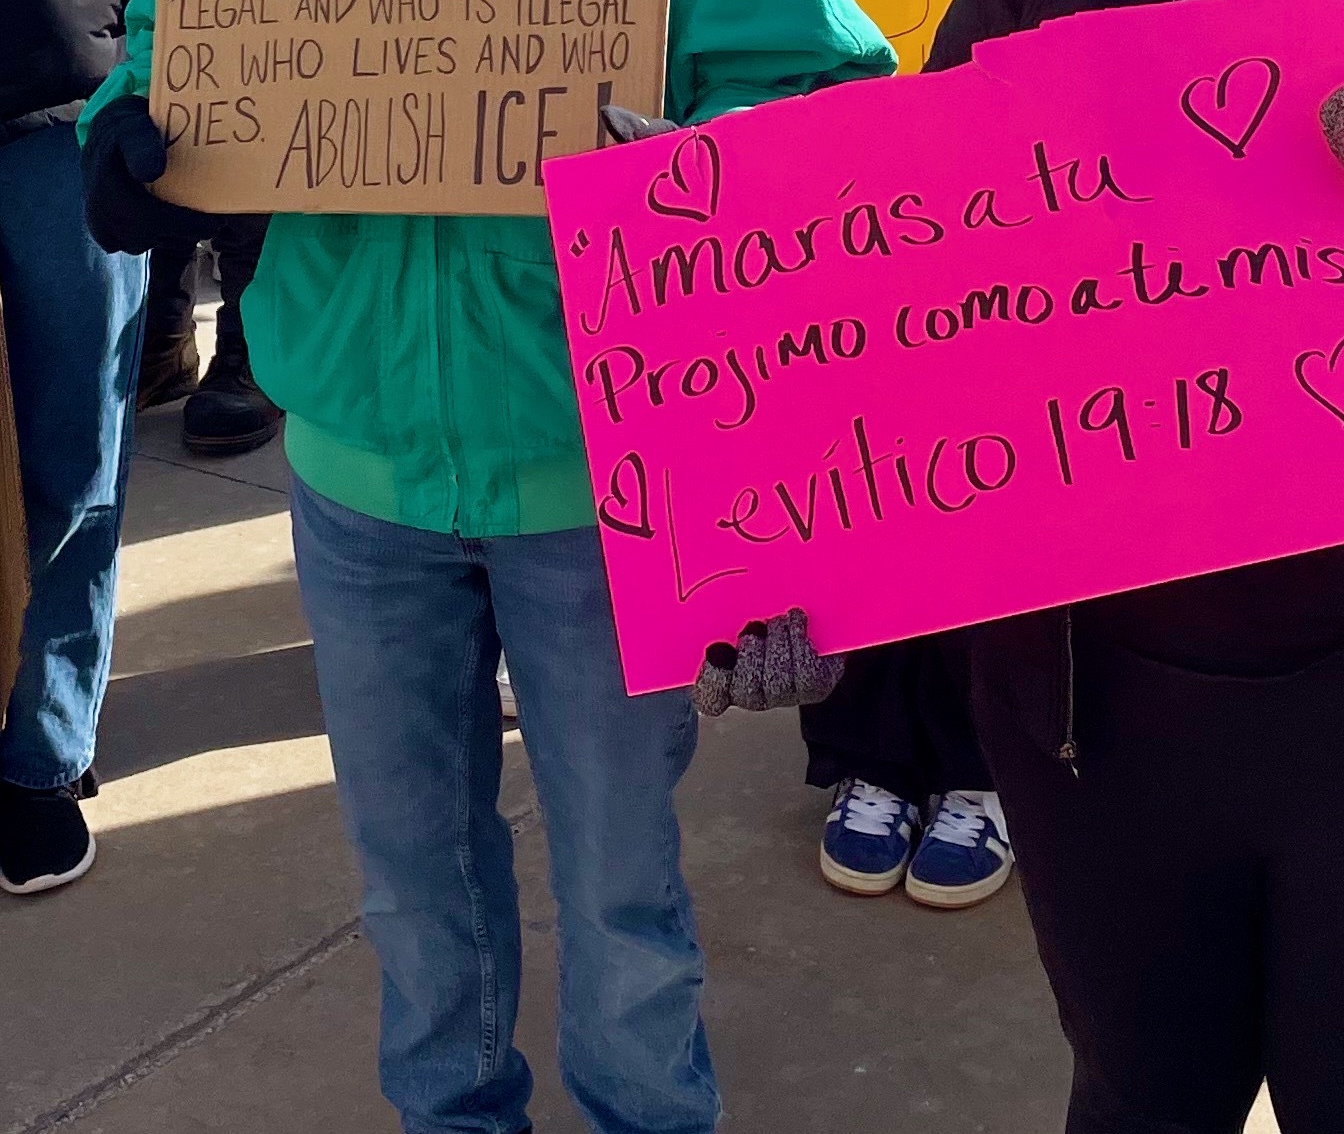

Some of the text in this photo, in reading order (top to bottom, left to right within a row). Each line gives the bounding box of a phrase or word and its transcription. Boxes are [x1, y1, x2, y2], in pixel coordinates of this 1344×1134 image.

[166, 32, 629, 92] OR WHO LIVES AND WHO
[164, 97, 266, 148] DIES.
[276, 92, 447, 189] ABOLISH
[962, 190, 1033, 229] a
[1026, 142, 1155, 212] tu
[895, 283, 1054, 348] como
[1071, 277, 1122, 316] a
[1117, 241, 1209, 305] ti
[664, 368, 1243, 603] Levítico 19:18
